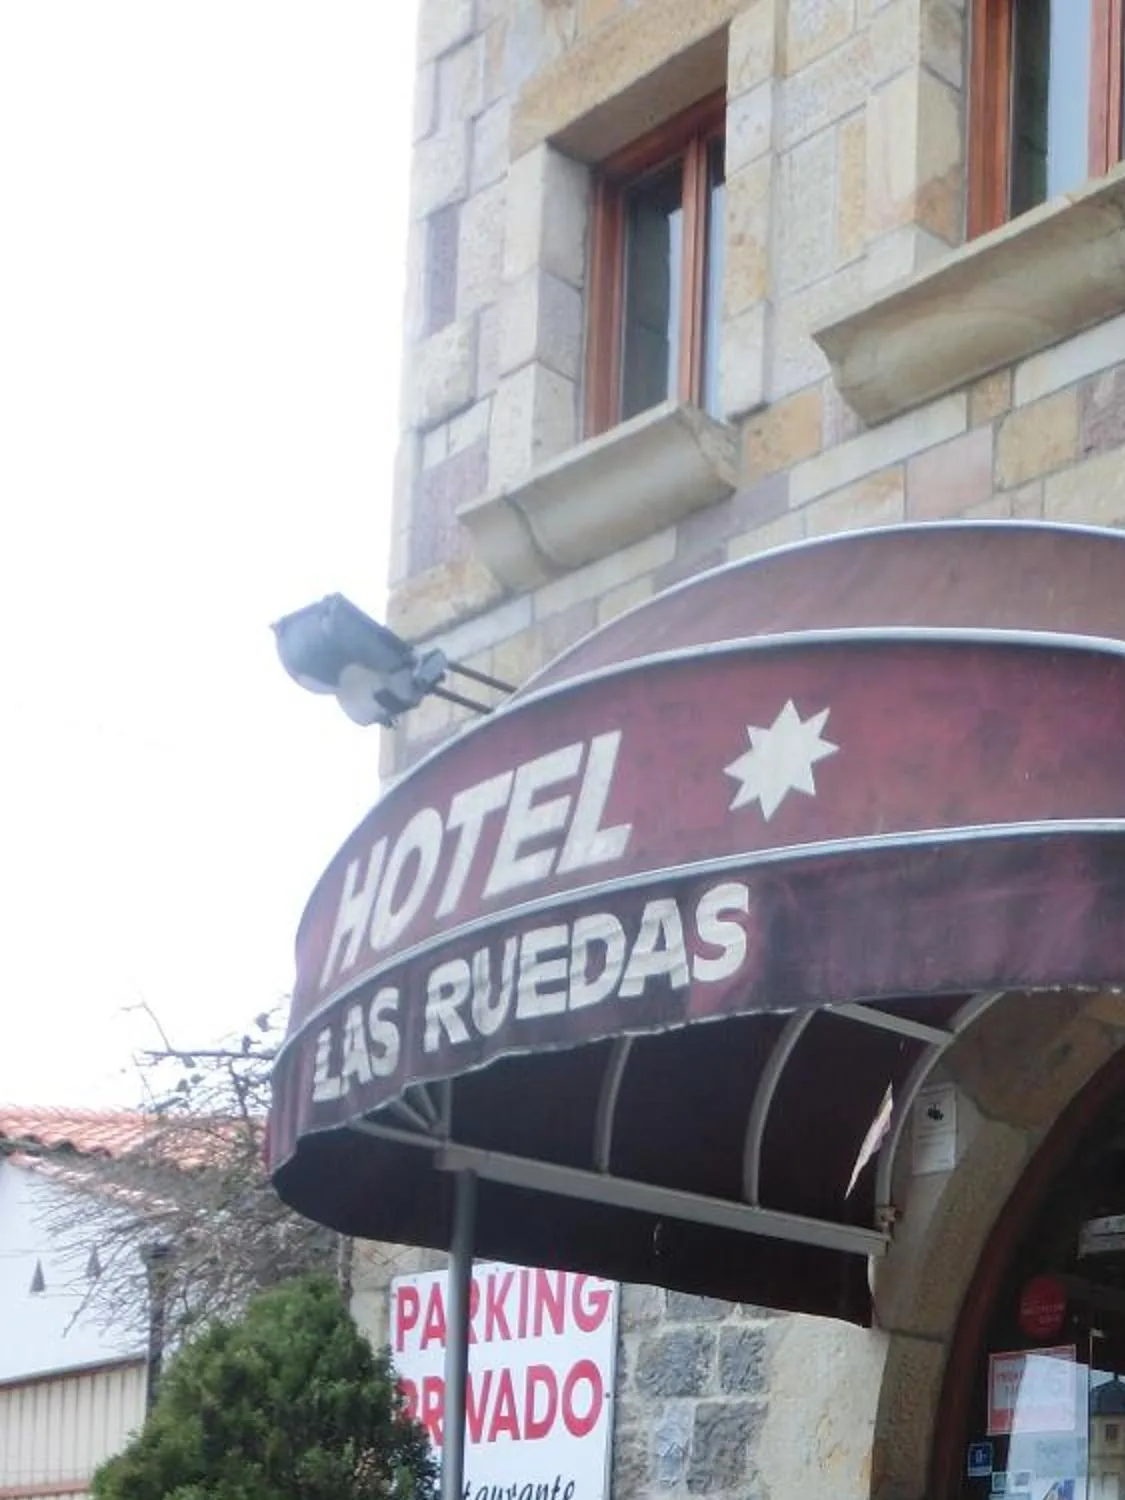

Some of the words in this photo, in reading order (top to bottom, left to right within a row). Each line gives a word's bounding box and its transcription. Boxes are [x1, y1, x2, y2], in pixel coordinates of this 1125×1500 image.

[320, 730, 632, 988] HOTEL
[312, 986, 401, 1102] LAS
[422, 882, 750, 1053] RUEDAS
[395, 1359, 604, 1447] RVADO
